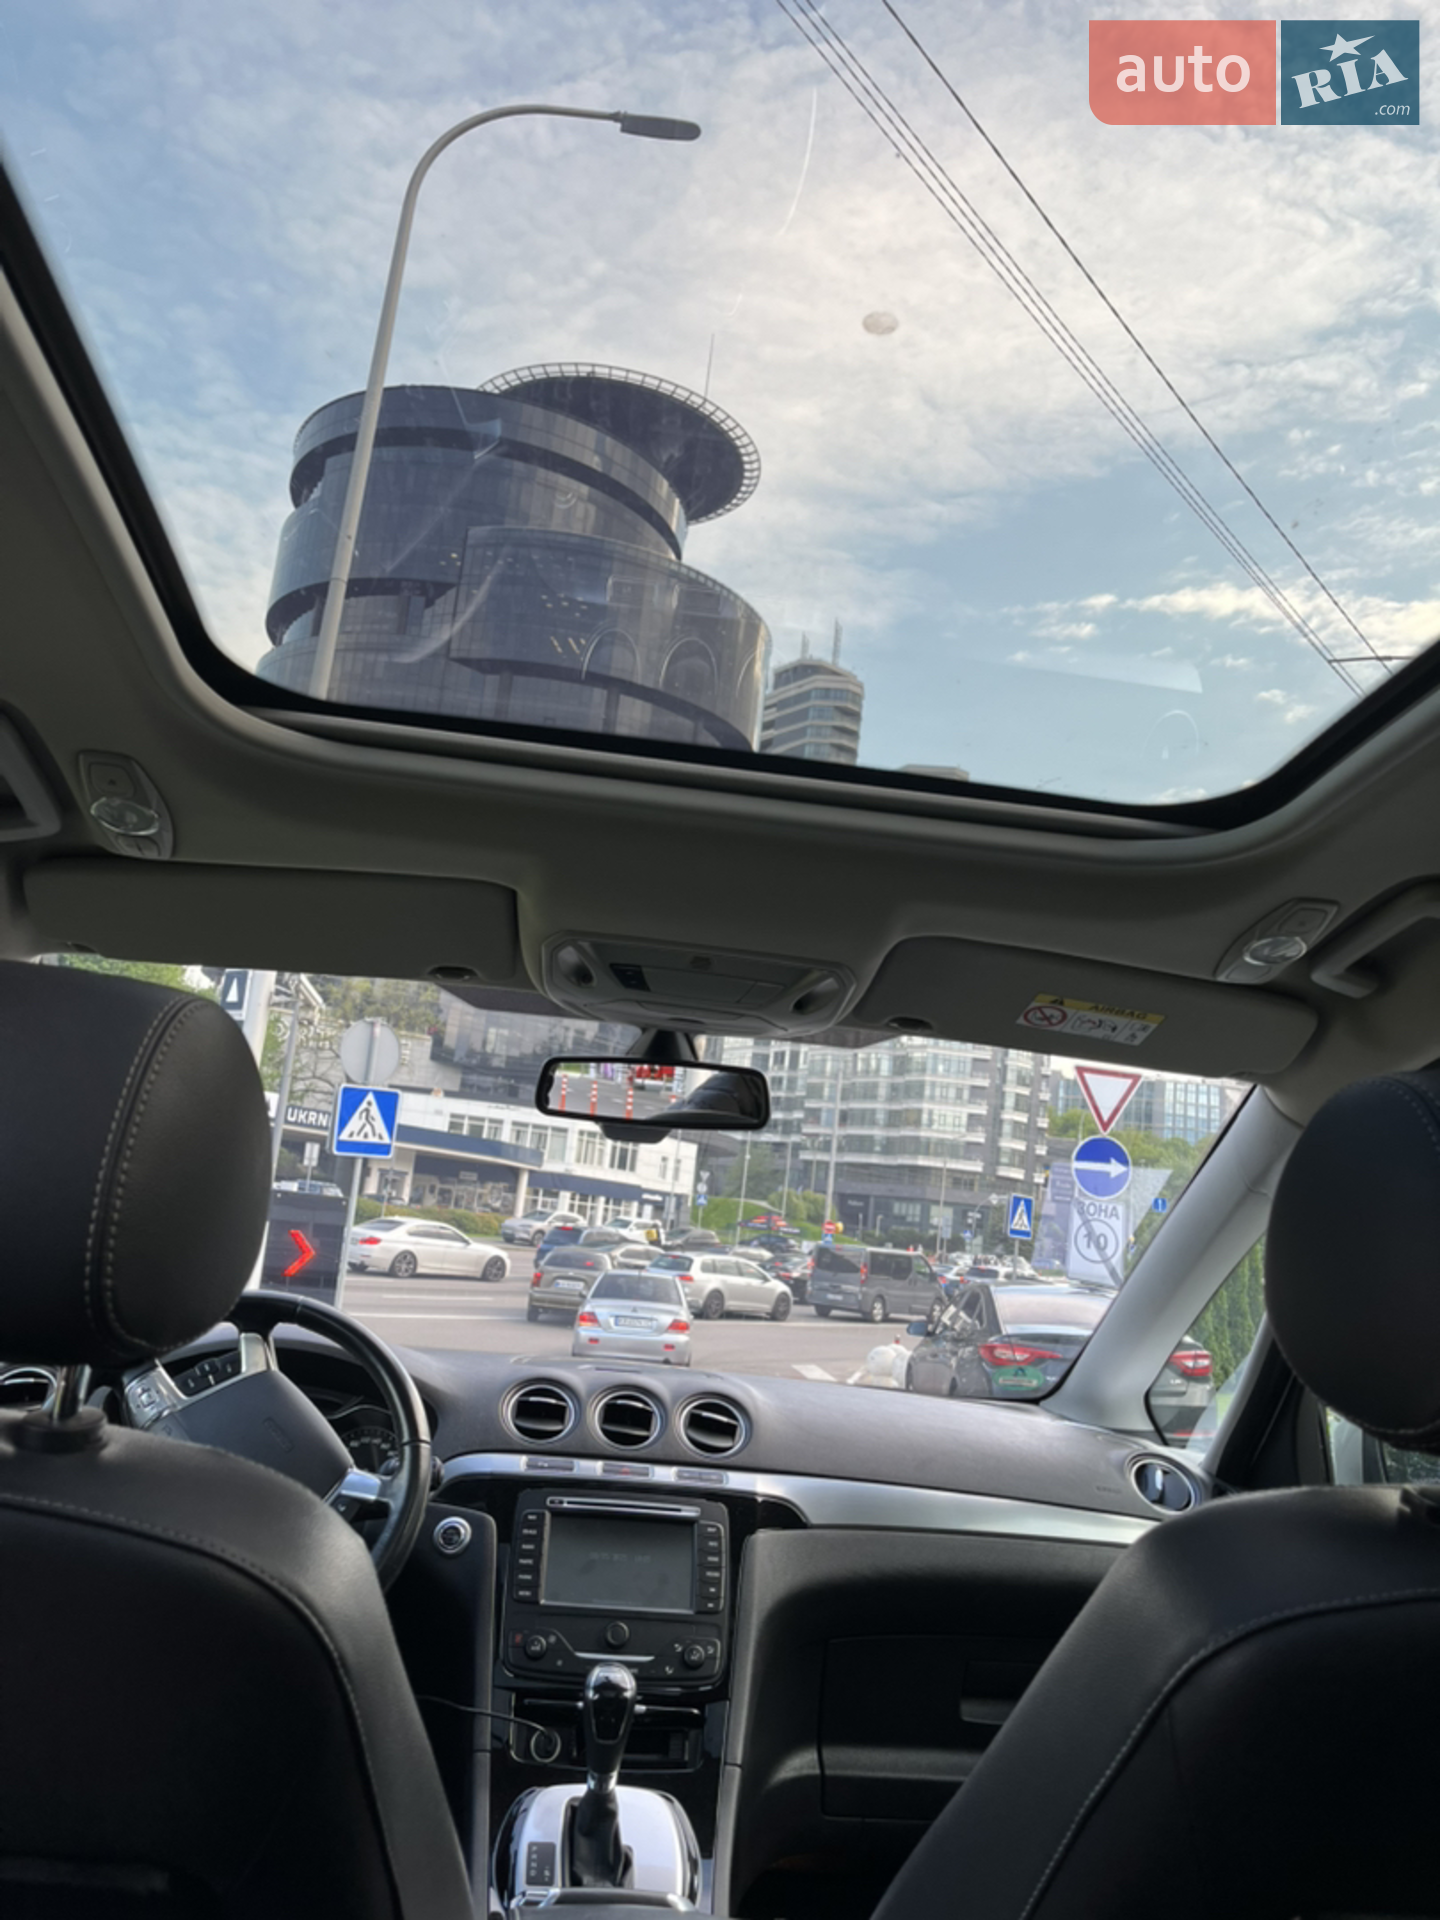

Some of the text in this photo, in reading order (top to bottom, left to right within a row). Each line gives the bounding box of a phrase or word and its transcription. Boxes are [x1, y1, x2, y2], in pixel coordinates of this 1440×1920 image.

[1089, 1005, 1147, 1019] AIRBAG
[287, 1107, 328, 1127] UKRN
[1077, 1201, 1120, 1220] ЗОНА
[1083, 1231, 1109, 1252] 10
